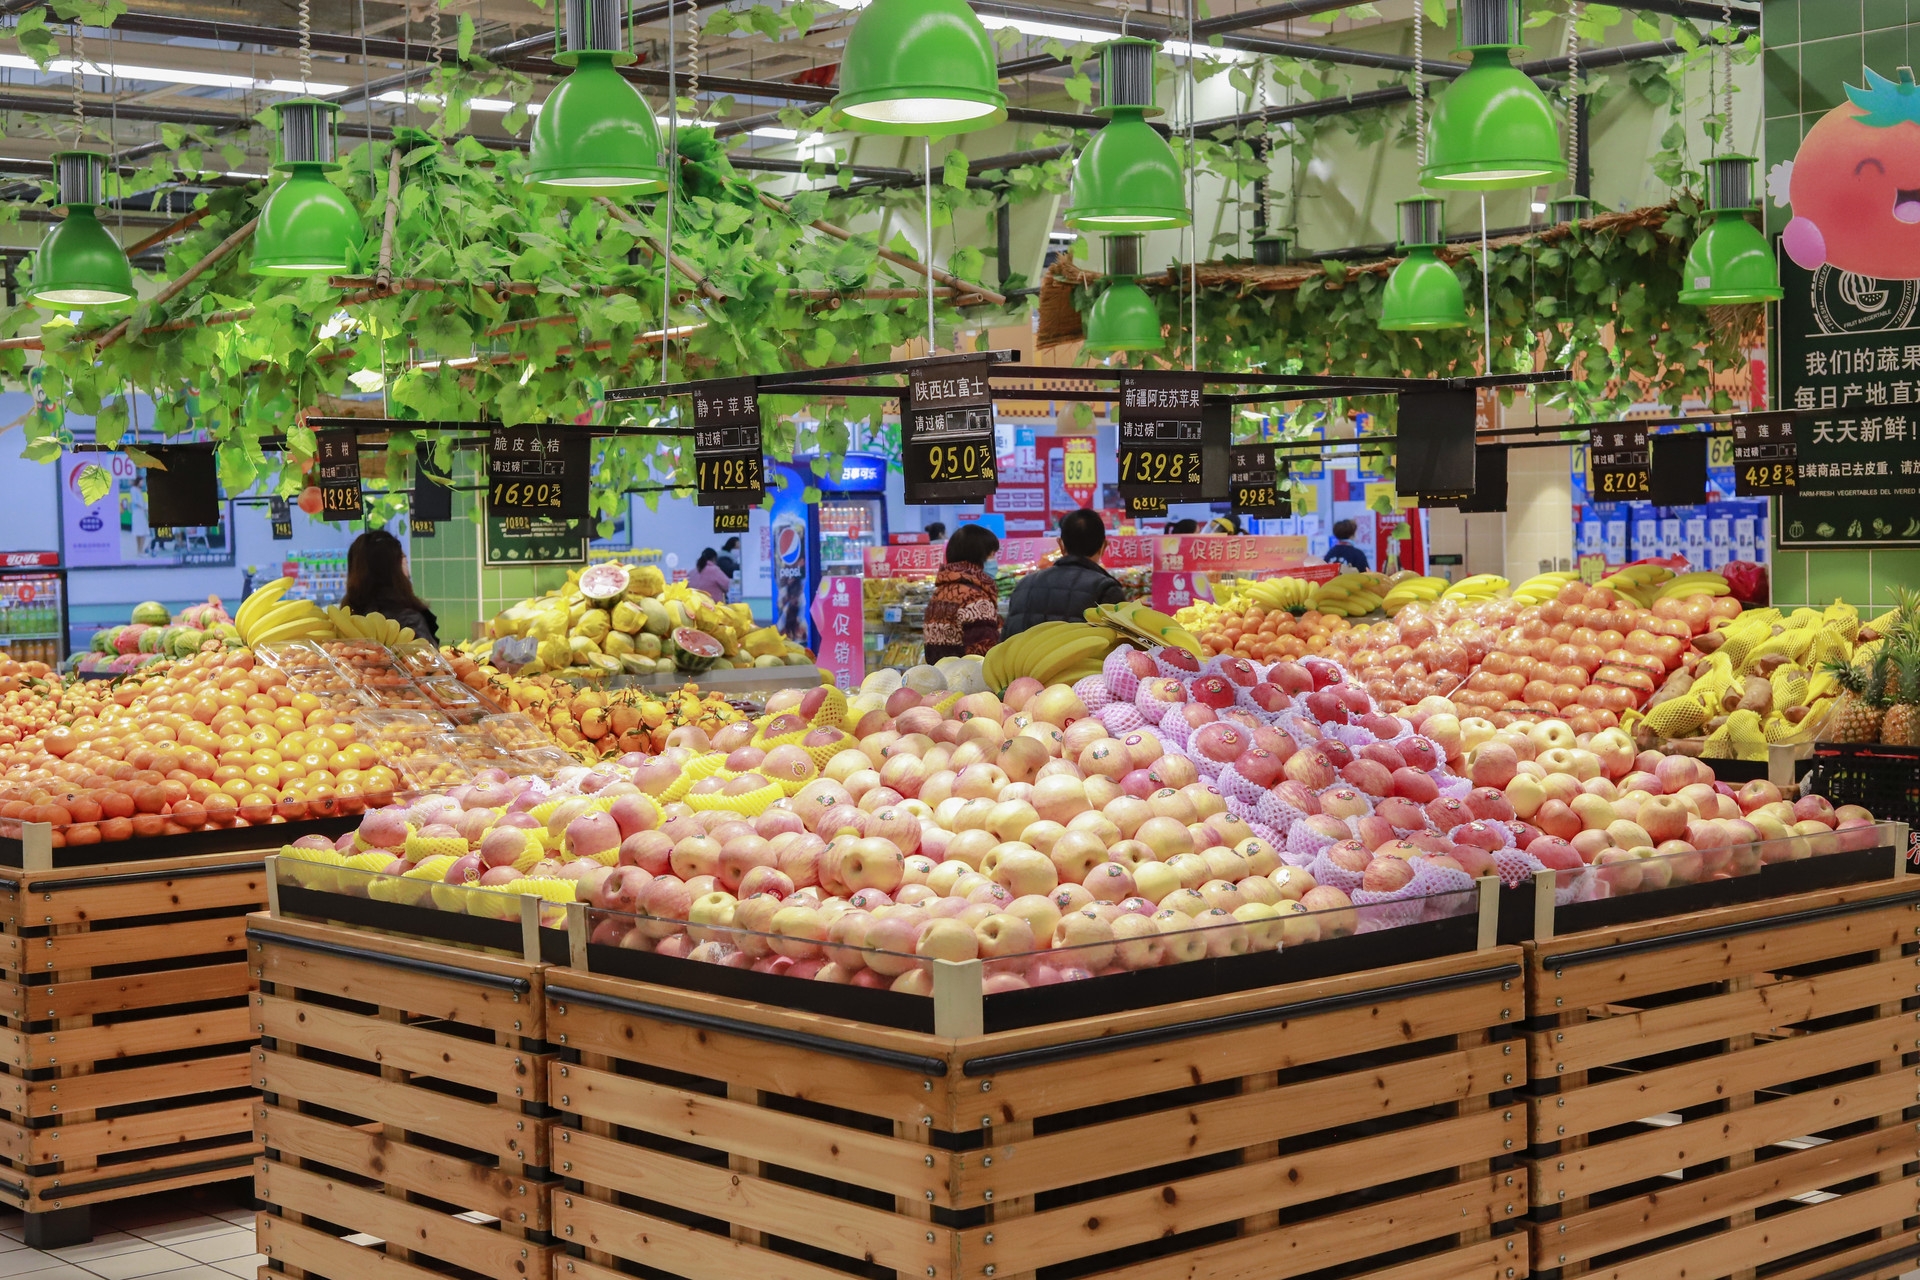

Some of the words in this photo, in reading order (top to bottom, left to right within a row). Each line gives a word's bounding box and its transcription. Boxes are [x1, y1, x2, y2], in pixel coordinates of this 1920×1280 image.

[1805, 344, 1920, 376] 我们的蔬果
[915, 376, 984, 401] 陕西红富士
[1125, 388, 1200, 408] 新疆阿克苏苹果
[697, 396, 755, 418] 静宁苹果
[915, 413, 945, 432] 请过磅
[1123, 421, 1155, 438] 请过磅
[1735, 423, 1792, 439] 雪莲果
[493, 437, 560, 453] 脆皮金桔
[696, 431, 721, 447] 请过磅
[1593, 433, 1645, 447] 波蜜柚
[325, 442, 349, 457] 贡柑
[1237, 453, 1265, 466] 沃柑
[492, 461, 521, 473] 请过磅
[929, 445, 976, 479] 9.50
[1121, 451, 1184, 481] 13.98
[699, 459, 745, 490] 11.98
[1603, 472, 1637, 493] 8.70
[1745, 464, 1783, 486] 4.98
[323, 487, 352, 510] 13.98
[494, 483, 549, 505] 16.90
[1239, 488, 1265, 506] 9.98
[1189, 537, 1259, 560] 促销商品
